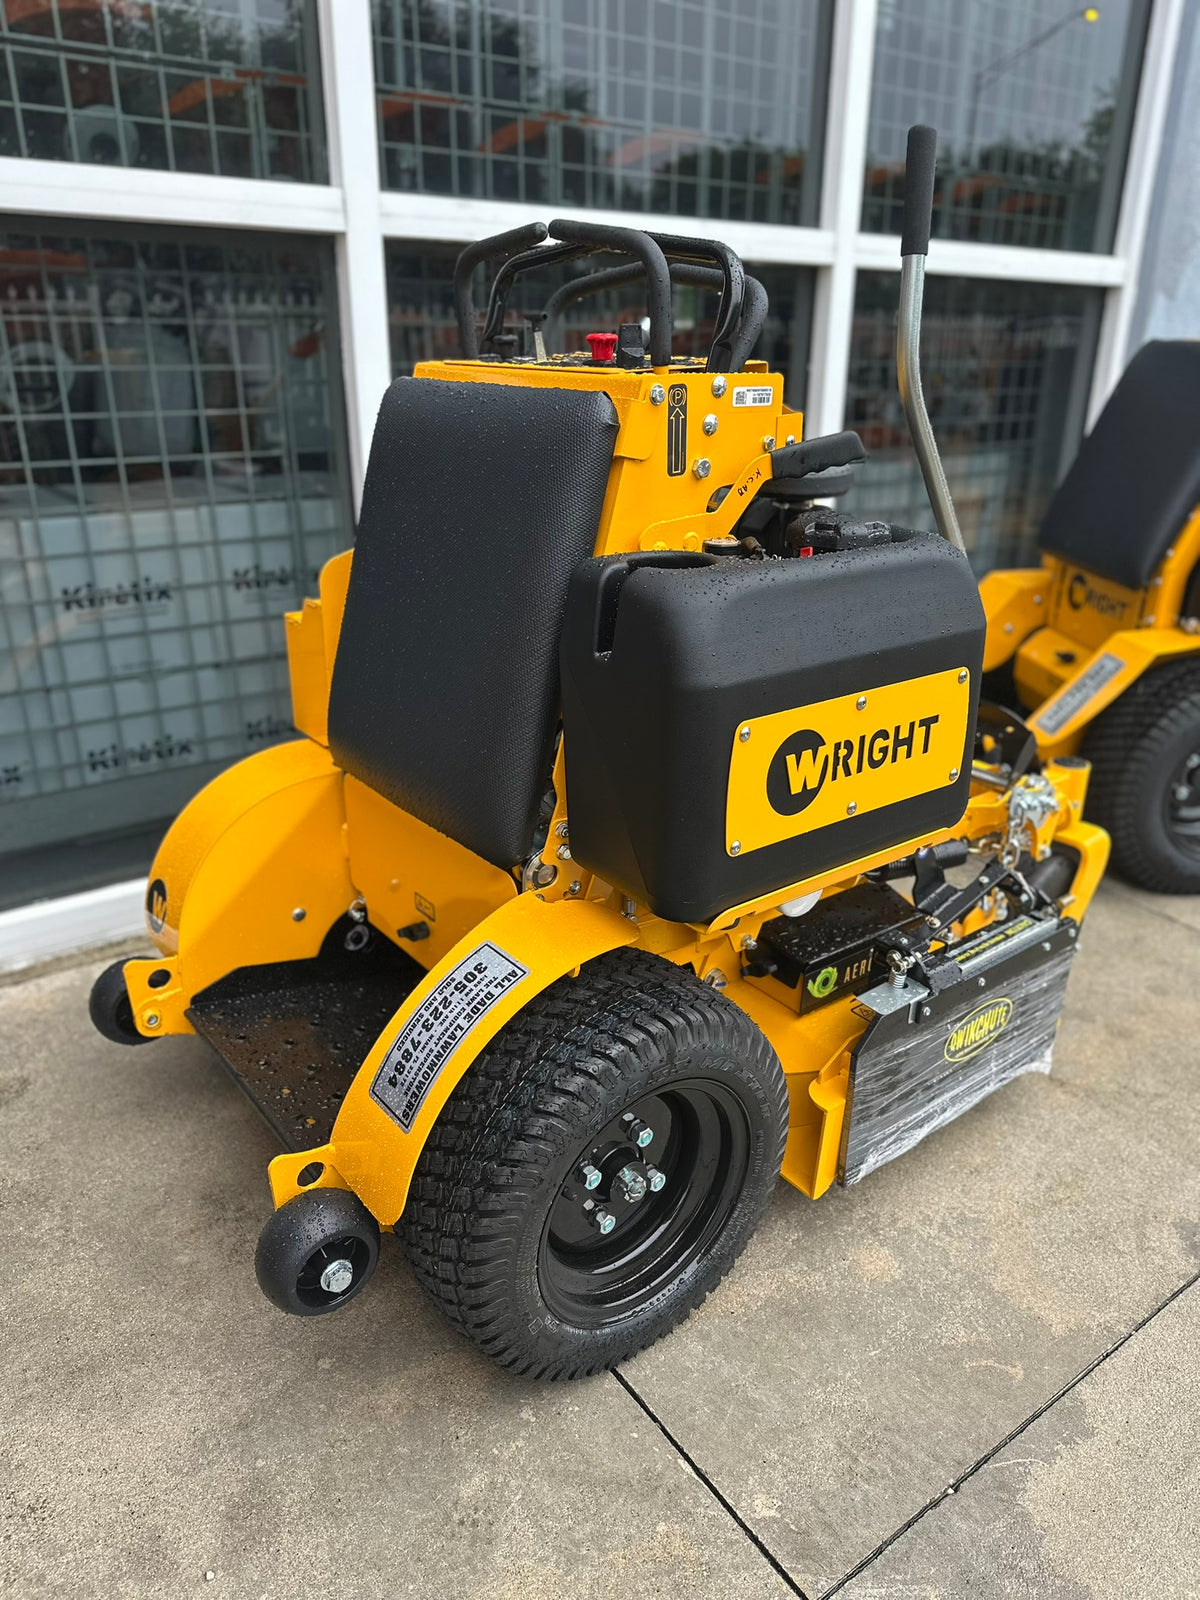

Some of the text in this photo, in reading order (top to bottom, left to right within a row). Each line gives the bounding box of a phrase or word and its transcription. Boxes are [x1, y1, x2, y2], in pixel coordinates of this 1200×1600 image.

[785, 714, 940, 796] WRIGHT
[387, 962, 488, 1089] 305-223-7884
[396, 976, 456, 1052] SOLD AND SERVICED
[464, 987, 474, 998] NW
[949, 1004, 1008, 1052] QWIKCHUTE
[402, 969, 519, 1120] ALL DADE LAWNMOWERS
[403, 976, 499, 1098] THE LAWN EQUIPMENT SUPERSTORE
[412, 1055, 419, 1064] FL
